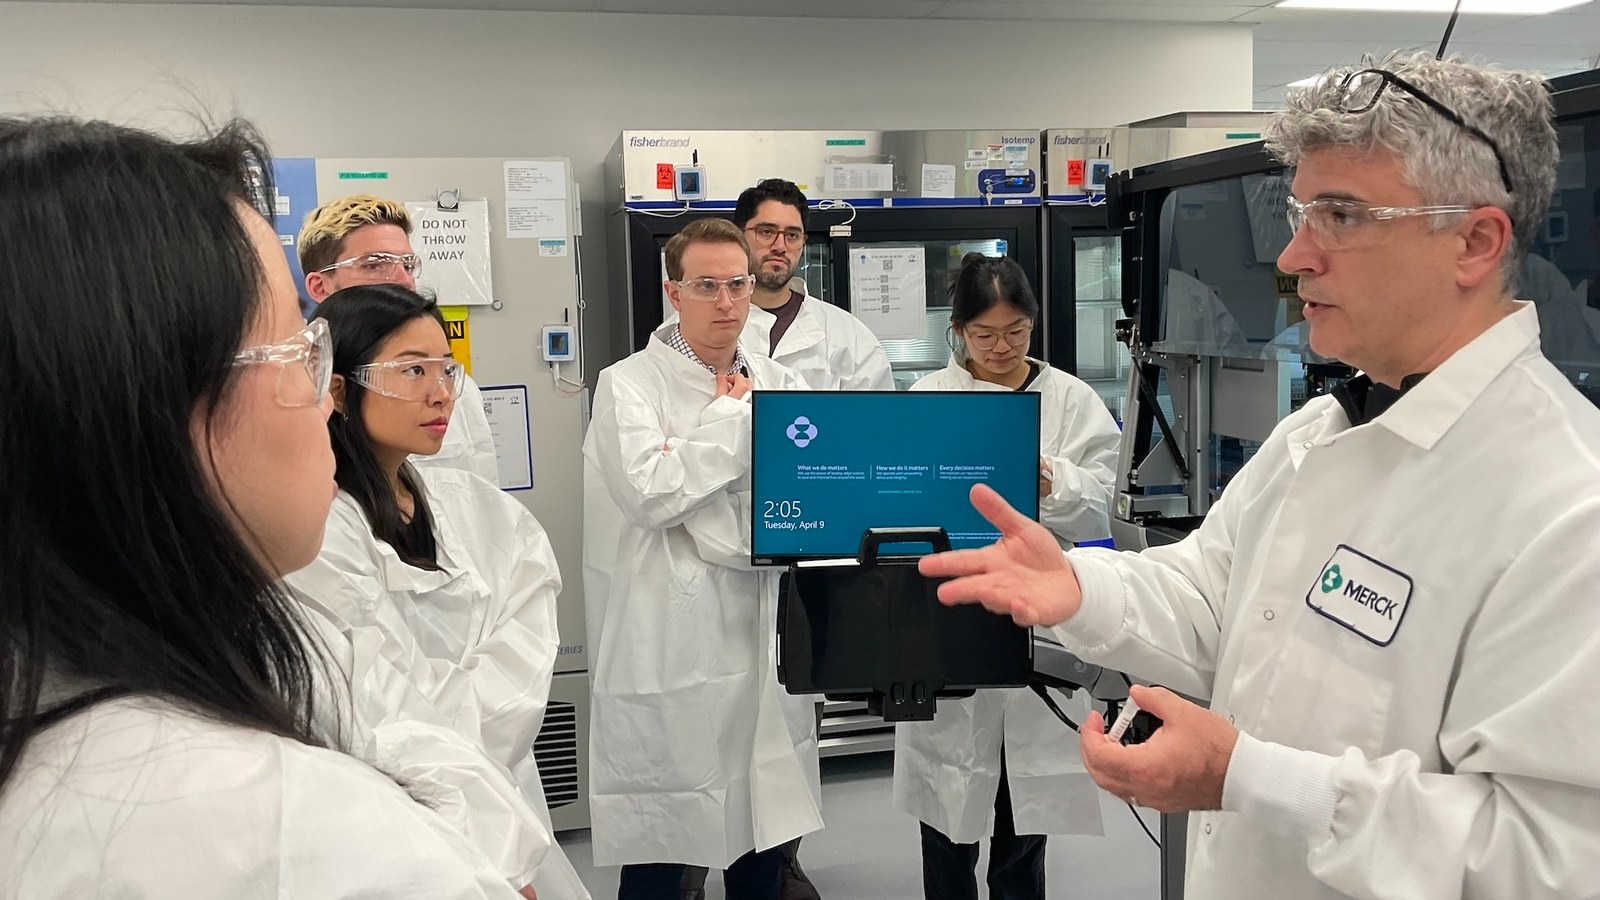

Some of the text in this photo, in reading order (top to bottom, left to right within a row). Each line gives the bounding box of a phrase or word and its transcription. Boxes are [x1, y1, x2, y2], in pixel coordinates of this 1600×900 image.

[630, 136, 690, 147] fisherbrand
[1001, 136, 1036, 144] Isotemp
[1054, 134, 1107, 145] fisherbrand
[422, 219, 467, 229] DO NOT
[422, 235, 466, 245] THROW
[429, 251, 464, 260] AWAY
[764, 501, 801, 518] 2:05
[764, 521, 825, 531] Tuesday, April 9
[1343, 579, 1399, 620] MERCK
